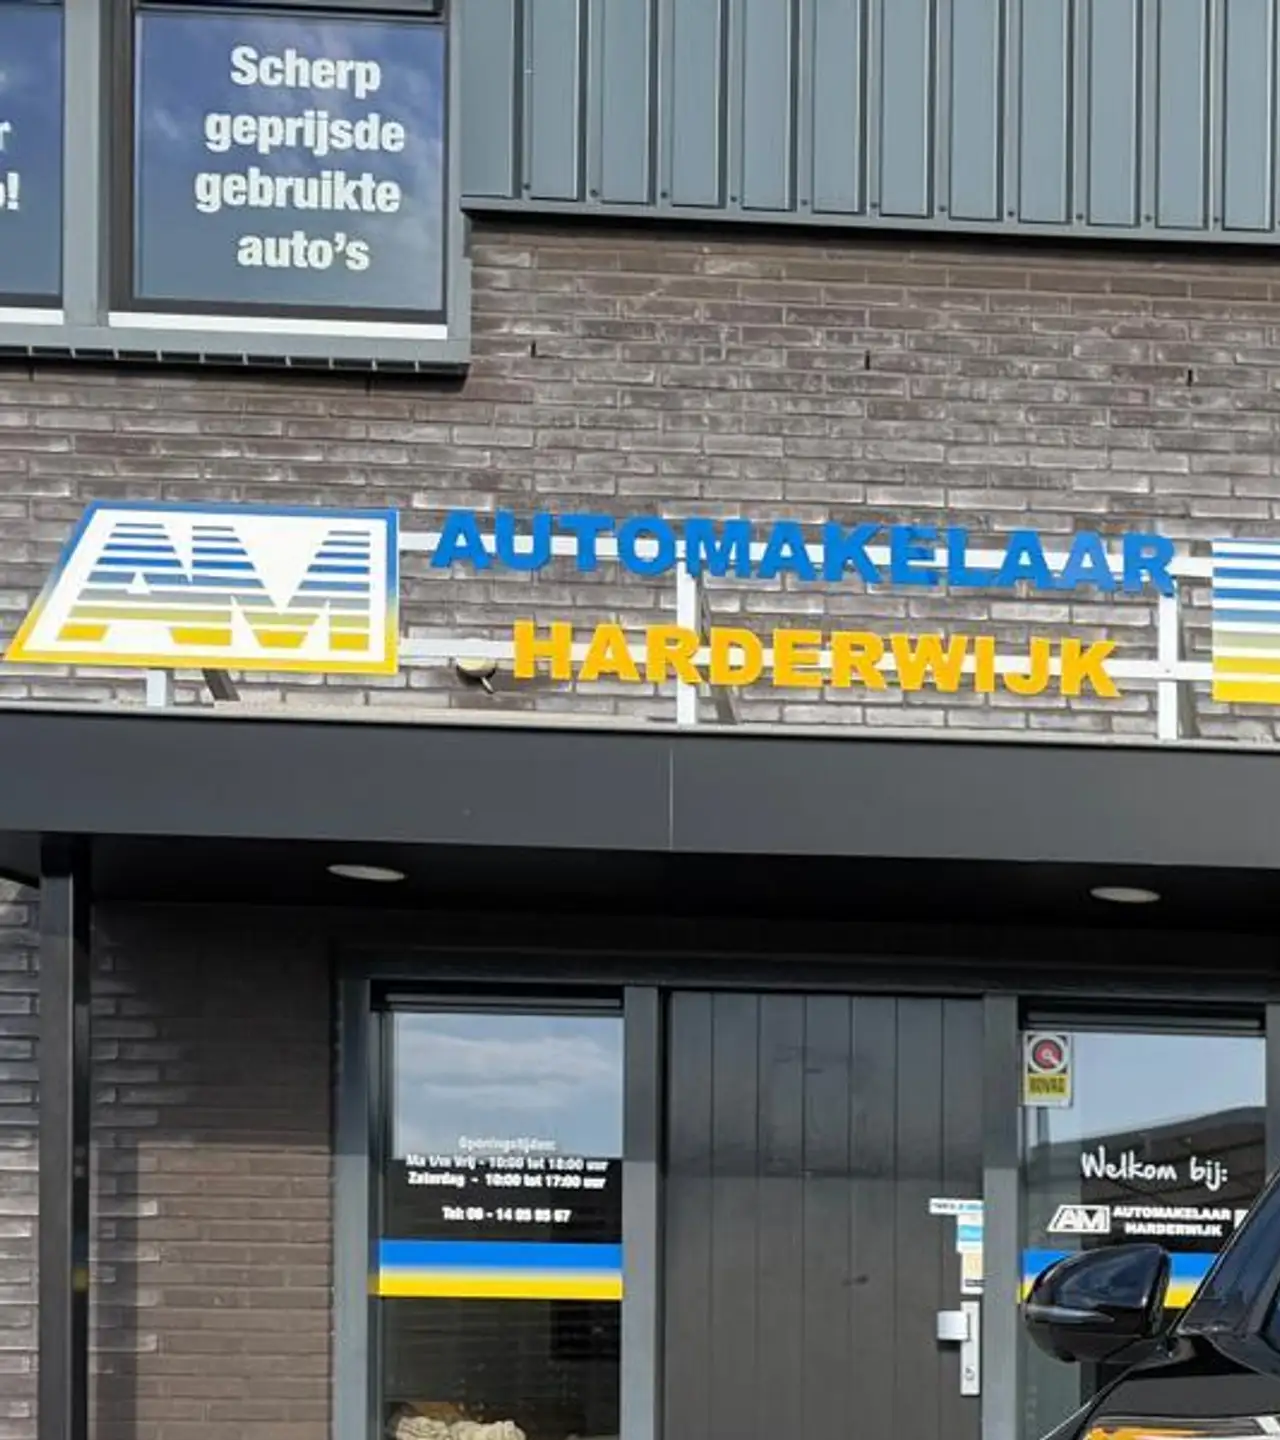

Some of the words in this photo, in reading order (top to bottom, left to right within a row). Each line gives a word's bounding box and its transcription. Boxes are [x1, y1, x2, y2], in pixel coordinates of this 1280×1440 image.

[230, 45, 381, 98] Scherp
[205, 110, 405, 156] geprijsde
[194, 167, 401, 213] gebruikte
[237, 231, 370, 271] auto's
[430, 509, 1177, 597] AUTOMAKELAAR
[56, 522, 371, 651] AM
[513, 620, 1123, 698] HARDERWIJK
[1081, 1145, 1177, 1181] Welkom
[1189, 1156, 1229, 1191] bij:
[1055, 1207, 1105, 1231] AM
[1112, 1205, 1232, 1221] AUTOMAKELAAR
[1124, 1222, 1223, 1237] HARDERWIJK
